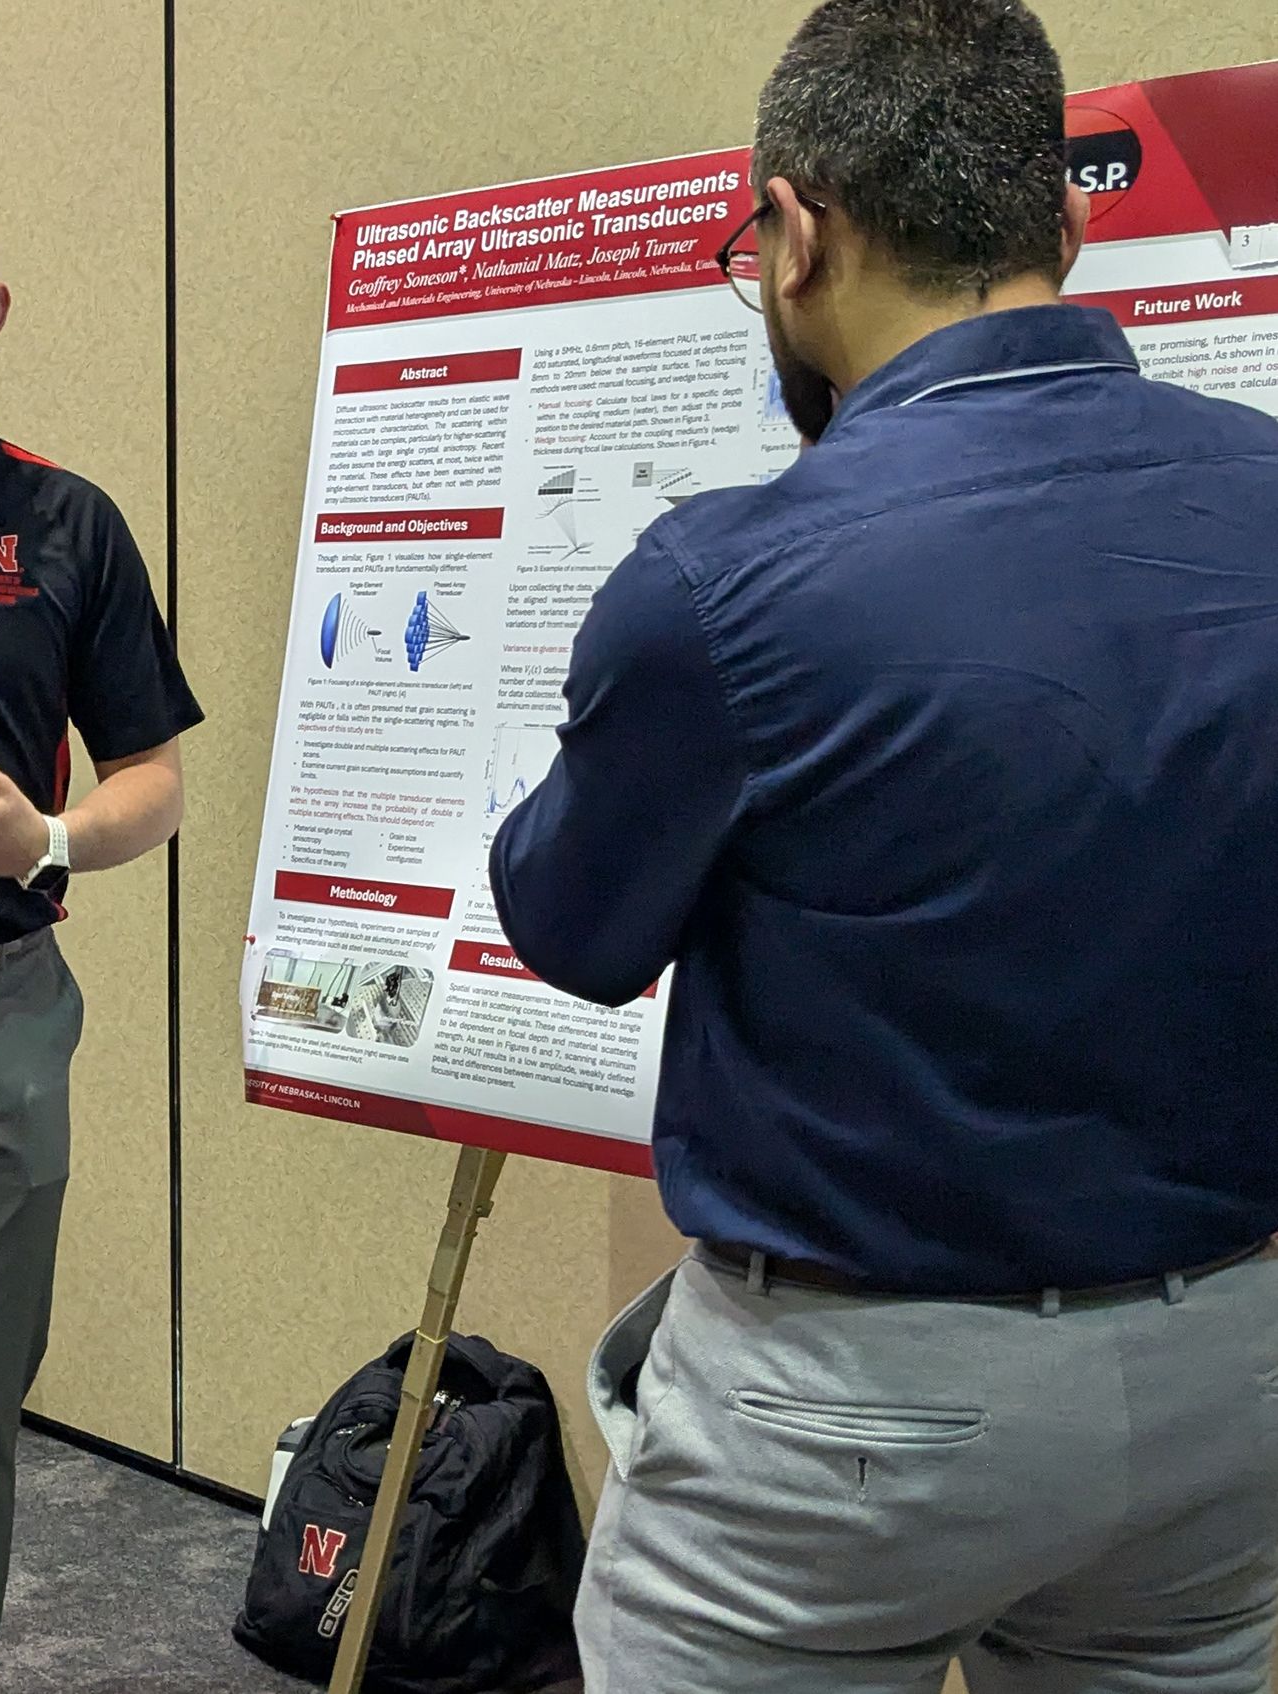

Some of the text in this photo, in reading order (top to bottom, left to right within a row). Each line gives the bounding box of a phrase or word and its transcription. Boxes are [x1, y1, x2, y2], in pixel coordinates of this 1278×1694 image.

[1065, 163, 1128, 193] S.P.
[356, 213, 449, 247] Ultrasonic
[453, 196, 574, 231] Backscatter
[577, 169, 740, 213] Measurements
[352, 201, 729, 271] Phased Array Ultrasonic Transducers
[1241, 234, 1250, 247] 3
[348, 275, 402, 298] Geoffrey
[472, 254, 542, 280] Nathanial
[544, 251, 583, 271] Matz,
[586, 240, 641, 267] Joseph
[645, 238, 700, 258] Turner
[386, 298, 400, 309] and
[400, 292, 436, 306] Materials
[485, 284, 524, 297] University
[524, 280, 535, 292] of
[534, 274, 572, 291] Nebraska
[579, 270, 612, 285] Lincoln,
[613, 267, 647, 282] Lincoln,
[649, 262, 692, 277] Nebraska,
[1133, 290, 1242, 317] Future Work
[1153, 346, 1274, 366] conclusions. As shown in
[1160, 337, 1208, 353] promising,
[1214, 333, 1247, 345] further
[400, 365, 448, 381] Abstract
[1152, 369, 1184, 380] exhibit
[1188, 367, 1207, 379] high
[1211, 365, 1237, 375] noise
[1242, 363, 1261, 373] and
[1204, 380, 1235, 391] curves
[320, 518, 468, 537] Background and Objectives
[329, 885, 398, 907] Methodology
[479, 952, 524, 970] Results
[443, 1006, 468, 1018] element
[534, 1020, 556, 1032] These
[599, 1030, 616, 1041] also
[617, 1035, 639, 1045] seem
[480, 1000, 488, 1009] in
[522, 1006, 549, 1018] content
[550, 1010, 570, 1021] when
[571, 1013, 608, 1028] compared
[609, 1019, 618, 1028] to
[618, 1020, 641, 1033] single
[440, 1017, 447, 1026] to
[448, 1019, 457, 1028] be
[458, 1020, 494, 1036] dependent
[496, 1028, 506, 1036] on
[508, 1028, 526, 1039] focal
[527, 1032, 549, 1045] depth
[551, 1036, 566, 1046] and
[567, 1038, 598, 1051] material
[465, 1034, 476, 1044] As
[477, 1038, 494, 1047] seen
[495, 1039, 503, 1048] in
[504, 1040, 530, 1054] Figures
[531, 1045, 537, 1054] 6
[538, 1046, 553, 1056] and
[563, 1050, 597, 1066] scanning
[598, 1056, 636, 1070] aluminum
[269, 1083, 279, 1094] of
[278, 1084, 361, 1109] NEBRASKA-LINCOLN
[298, 1524, 347, 1578] N
